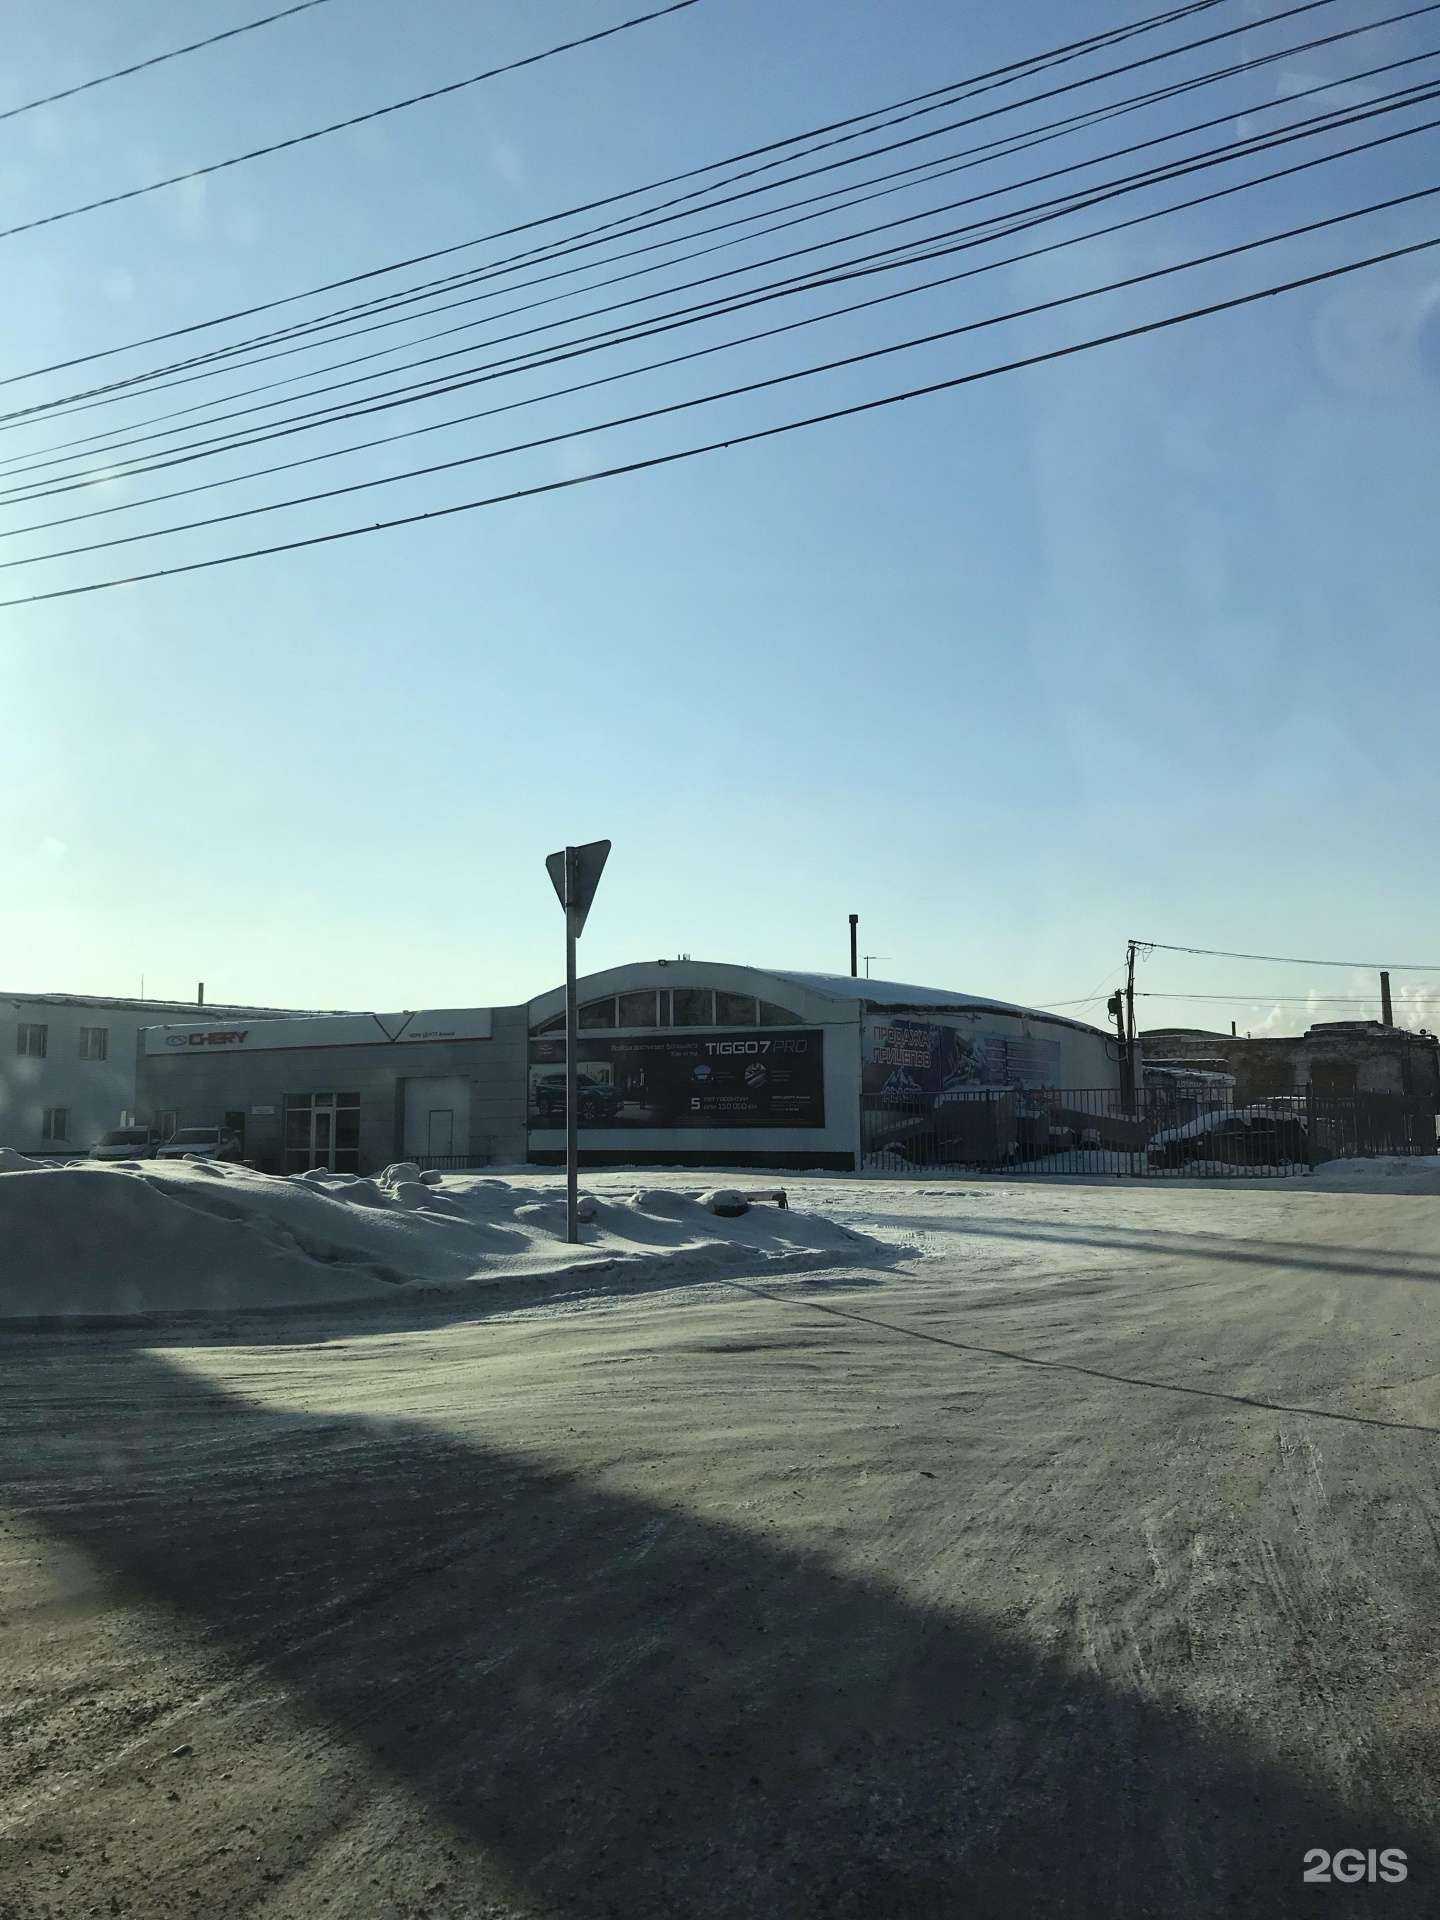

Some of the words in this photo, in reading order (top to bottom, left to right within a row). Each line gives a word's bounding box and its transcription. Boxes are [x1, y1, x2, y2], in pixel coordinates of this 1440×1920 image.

[189, 1031, 249, 1045] CHERY
[873, 1026, 928, 1050] ПРОДАЖА
[772, 1039, 808, 1053] PRO
[873, 1047, 931, 1068] ПРИЦЕПОВ
[691, 1097, 701, 1110] 5
